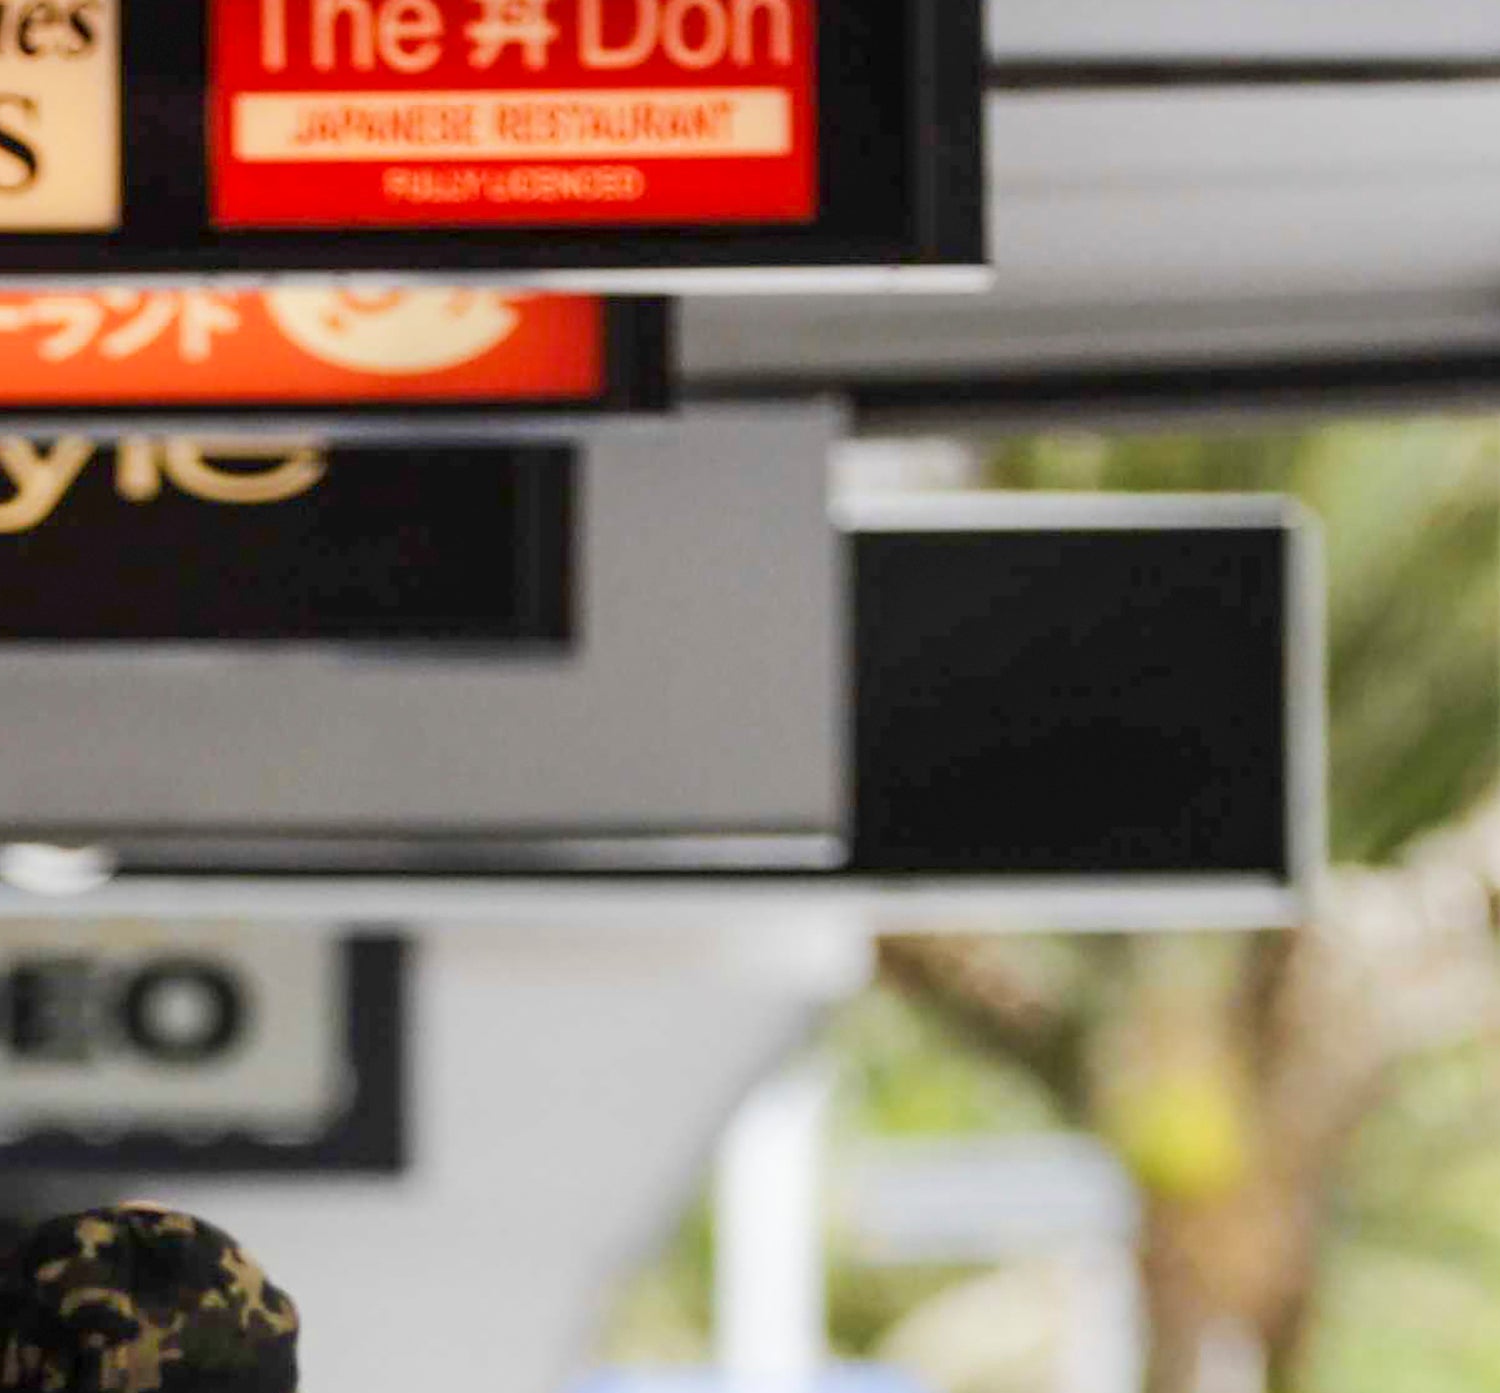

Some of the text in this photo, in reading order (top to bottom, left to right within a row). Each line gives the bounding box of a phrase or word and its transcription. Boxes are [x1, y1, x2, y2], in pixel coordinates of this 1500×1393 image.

[256, 0, 445, 73] The
[576, 0, 796, 70] Don
[293, 97, 737, 146] JAPANESE RESTAURANT
